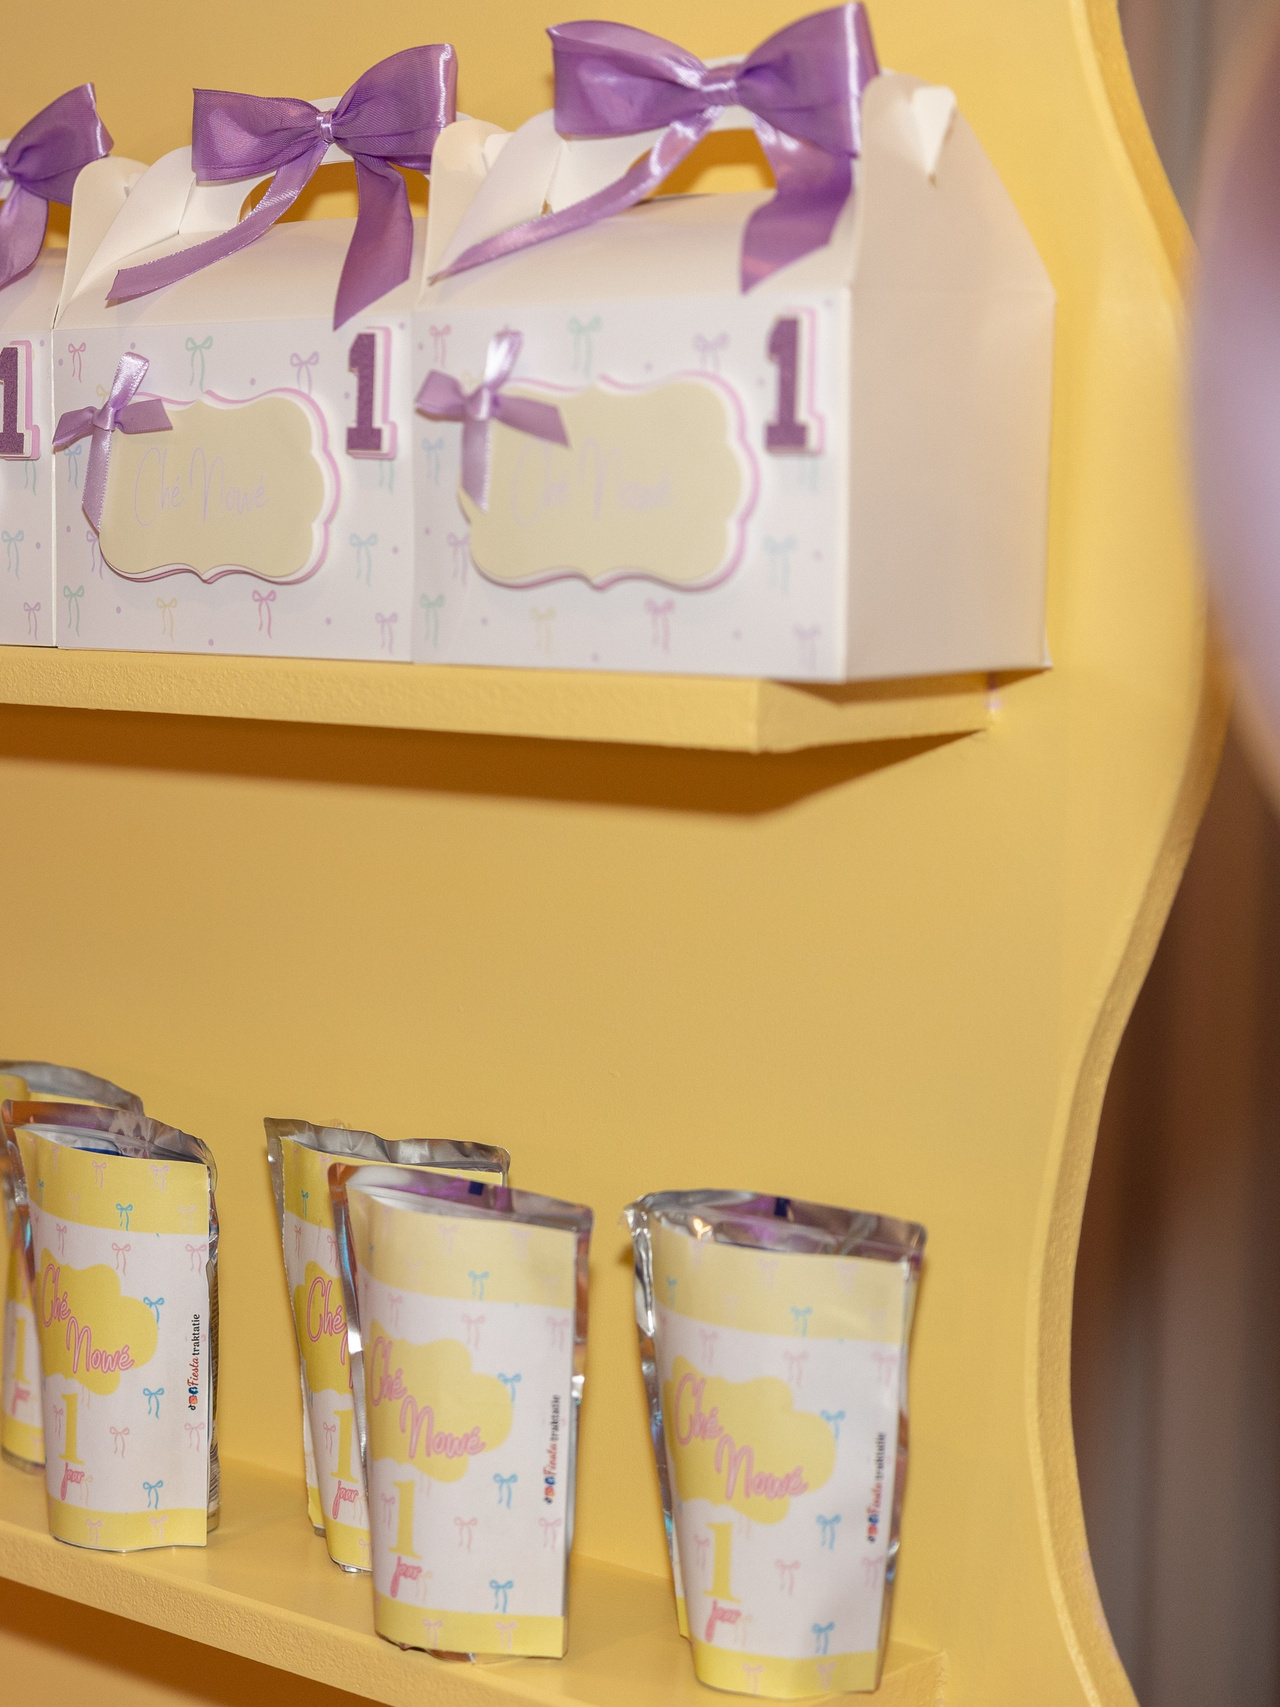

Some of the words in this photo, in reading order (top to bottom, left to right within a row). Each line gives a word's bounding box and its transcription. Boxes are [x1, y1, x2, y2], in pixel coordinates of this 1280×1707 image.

[346, 332, 383, 453] 1
[765, 315, 808, 453] 1
[134, 446, 186, 527] Ché
[189, 446, 270, 524] Nowé
[41, 1262, 72, 1328] Ché
[306, 1276, 348, 1343] Ché
[65, 1315, 136, 1375] Nowé
[191, 1313, 201, 1356] traktatie
[187, 1356, 199, 1387] Fiesta
[370, 1336, 408, 1407] Ché
[58, 1392, 86, 1466] 1
[399, 1394, 487, 1460] Nowé
[675, 1372, 724, 1447] Ché
[330, 1408, 360, 1484] 1
[332, 1479, 360, 1520] jaar
[388, 1480, 423, 1560] 1
[702, 1522, 743, 1604] 1
